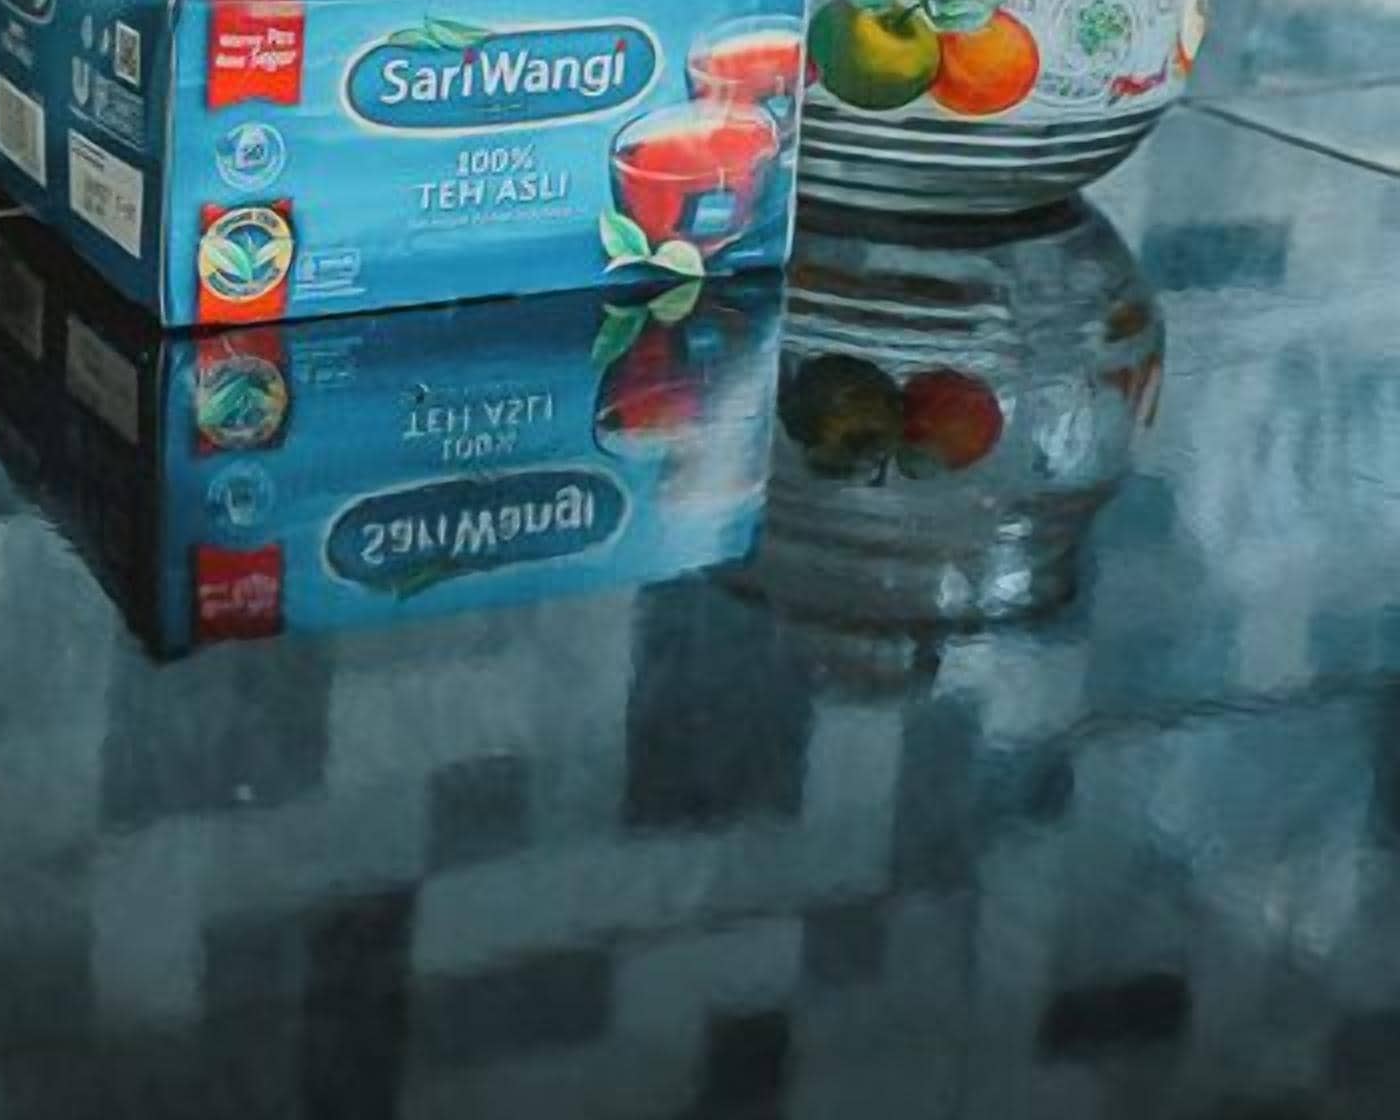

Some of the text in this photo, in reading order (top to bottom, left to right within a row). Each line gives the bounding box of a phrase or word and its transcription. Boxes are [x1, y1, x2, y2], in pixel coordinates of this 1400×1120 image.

[456, 144, 536, 178] 100%
[414, 170, 569, 211] TEH ASLI
